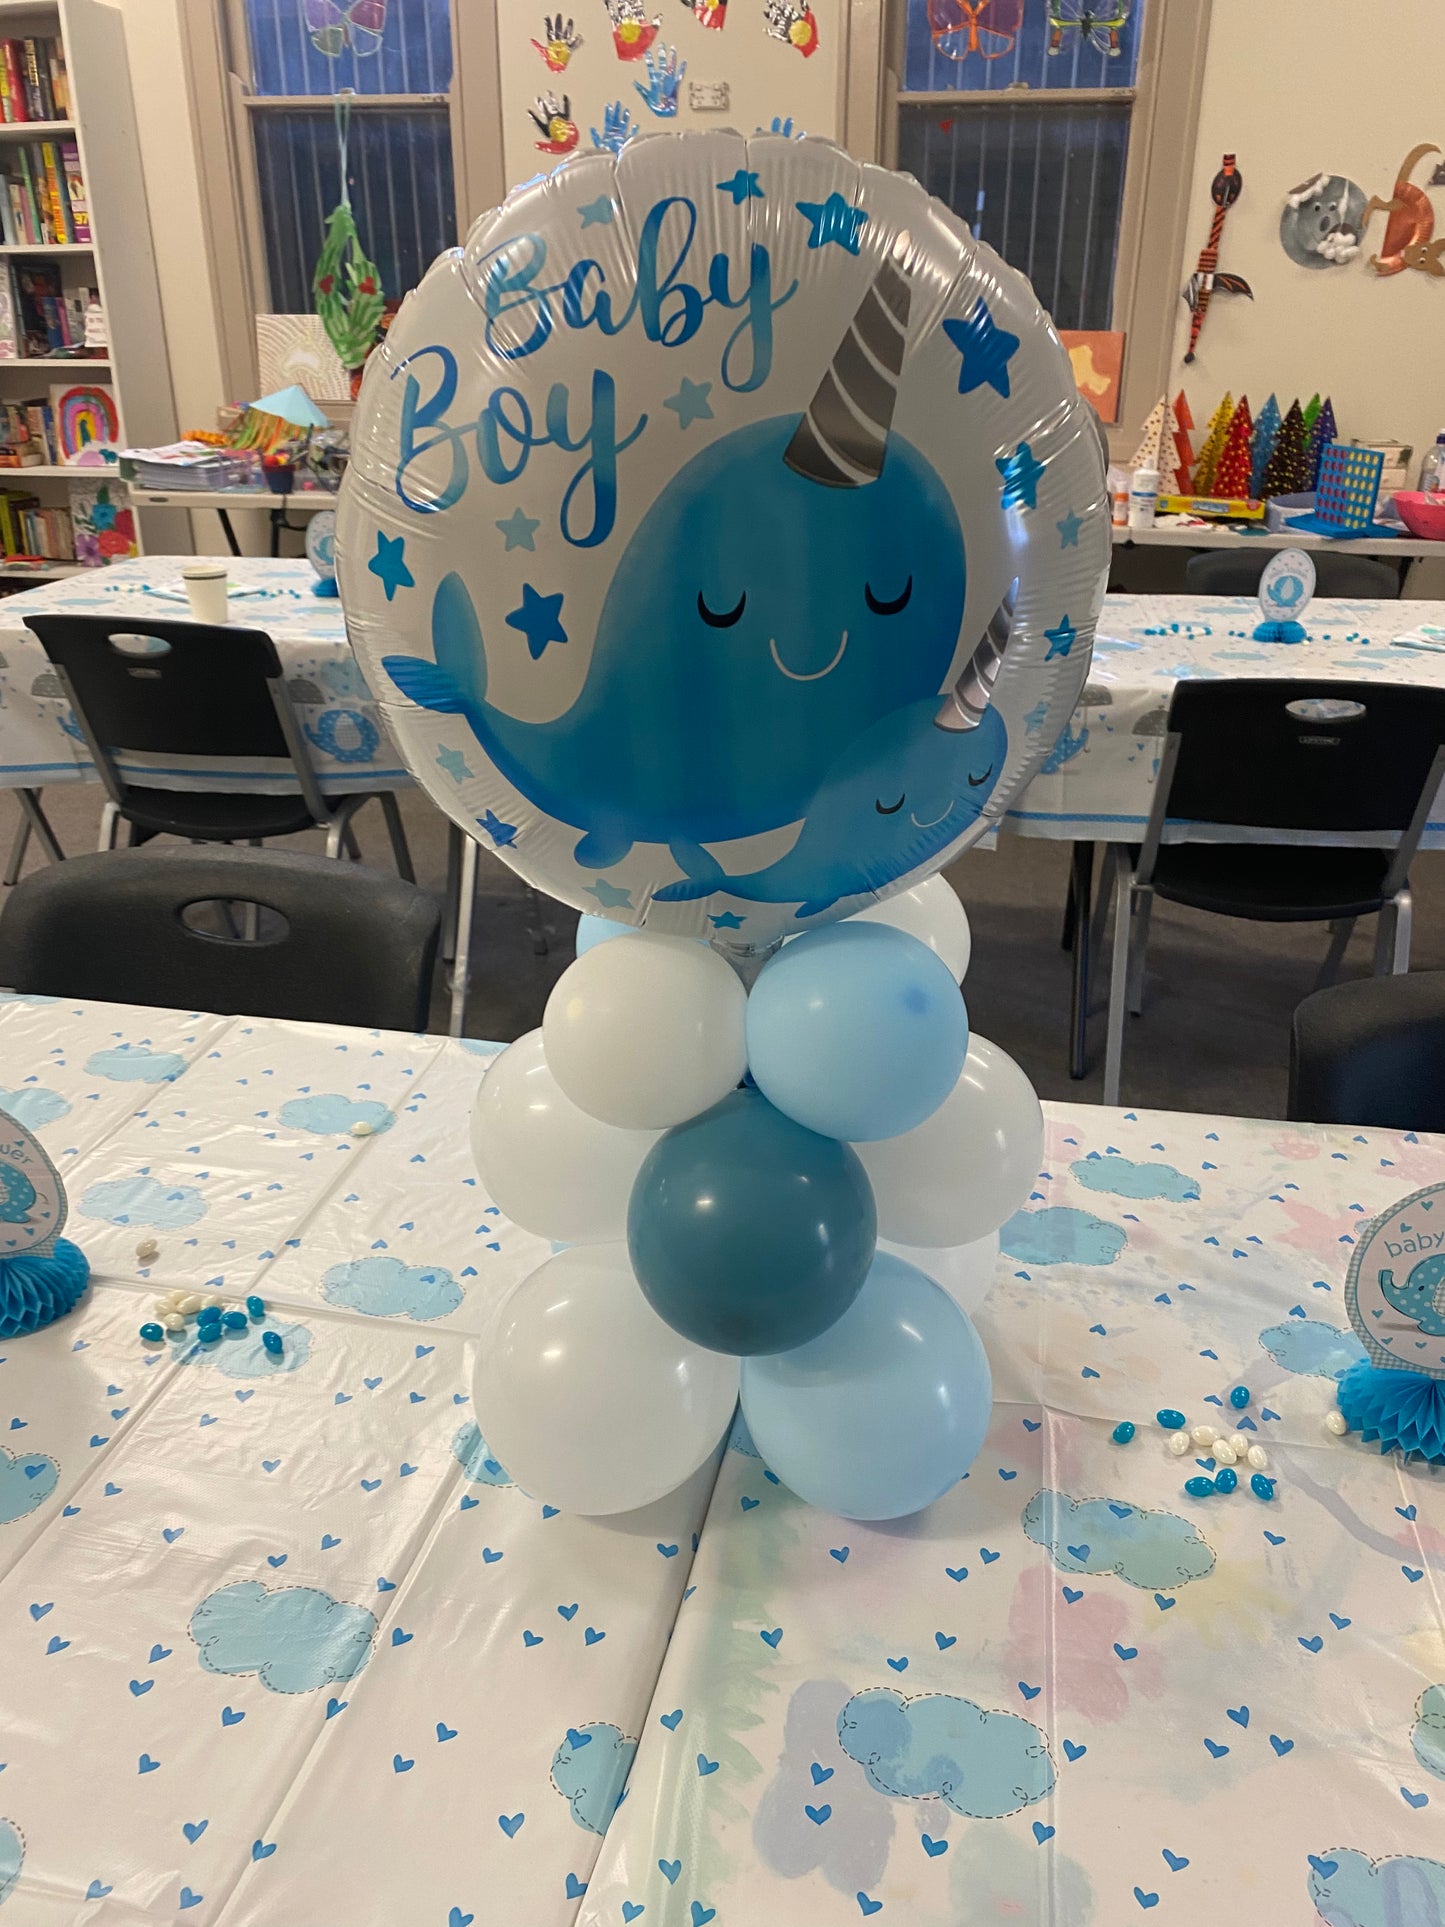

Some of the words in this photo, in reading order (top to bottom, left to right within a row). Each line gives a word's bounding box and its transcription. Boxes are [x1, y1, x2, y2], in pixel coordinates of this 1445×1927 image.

[477, 197, 798, 392] Baby
[391, 345, 648, 548] Boy
[1384, 1231, 1445, 1258] baby
